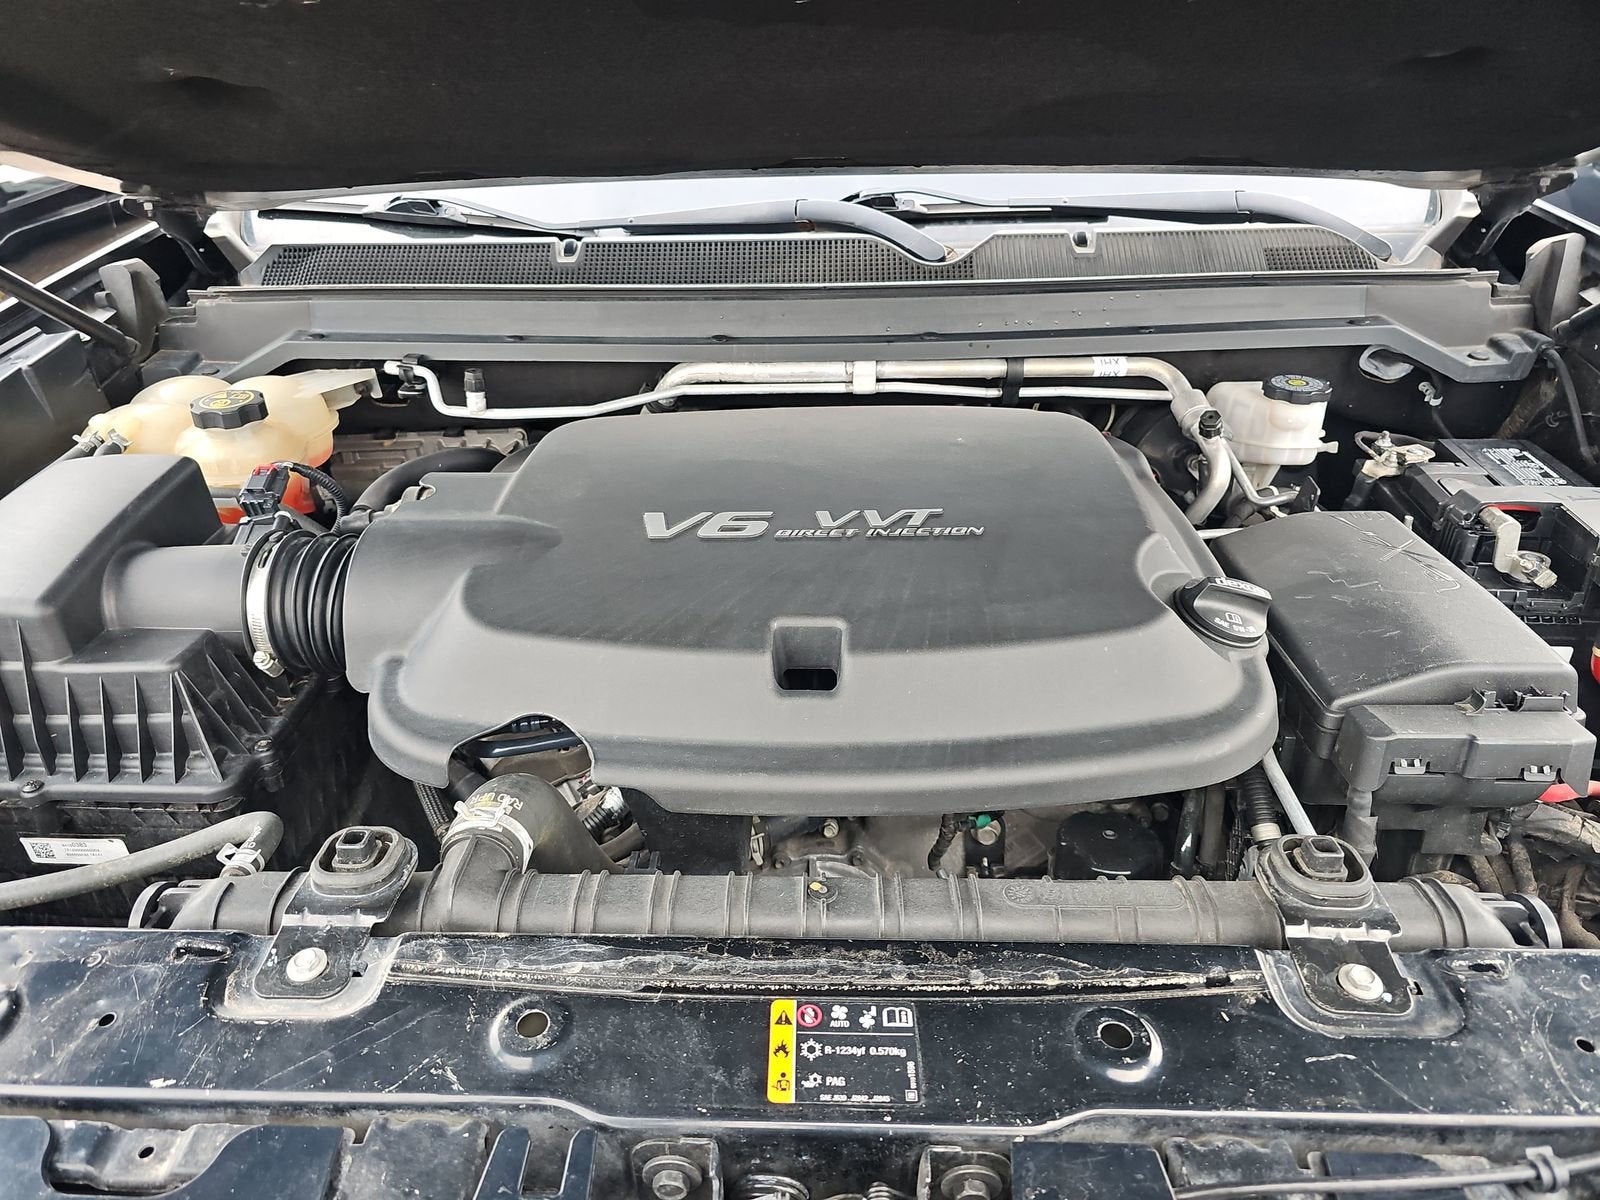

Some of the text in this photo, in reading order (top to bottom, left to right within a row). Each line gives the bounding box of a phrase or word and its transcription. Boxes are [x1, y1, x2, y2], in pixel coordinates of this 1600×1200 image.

[644, 508, 944, 539] V6 VVT
[774, 526, 985, 539] DIRECT INJECTION
[829, 1019, 850, 1028] AUTO
[824, 1045, 907, 1058] R-1234yf 0.570kg
[825, 1076, 846, 1087] PAG
